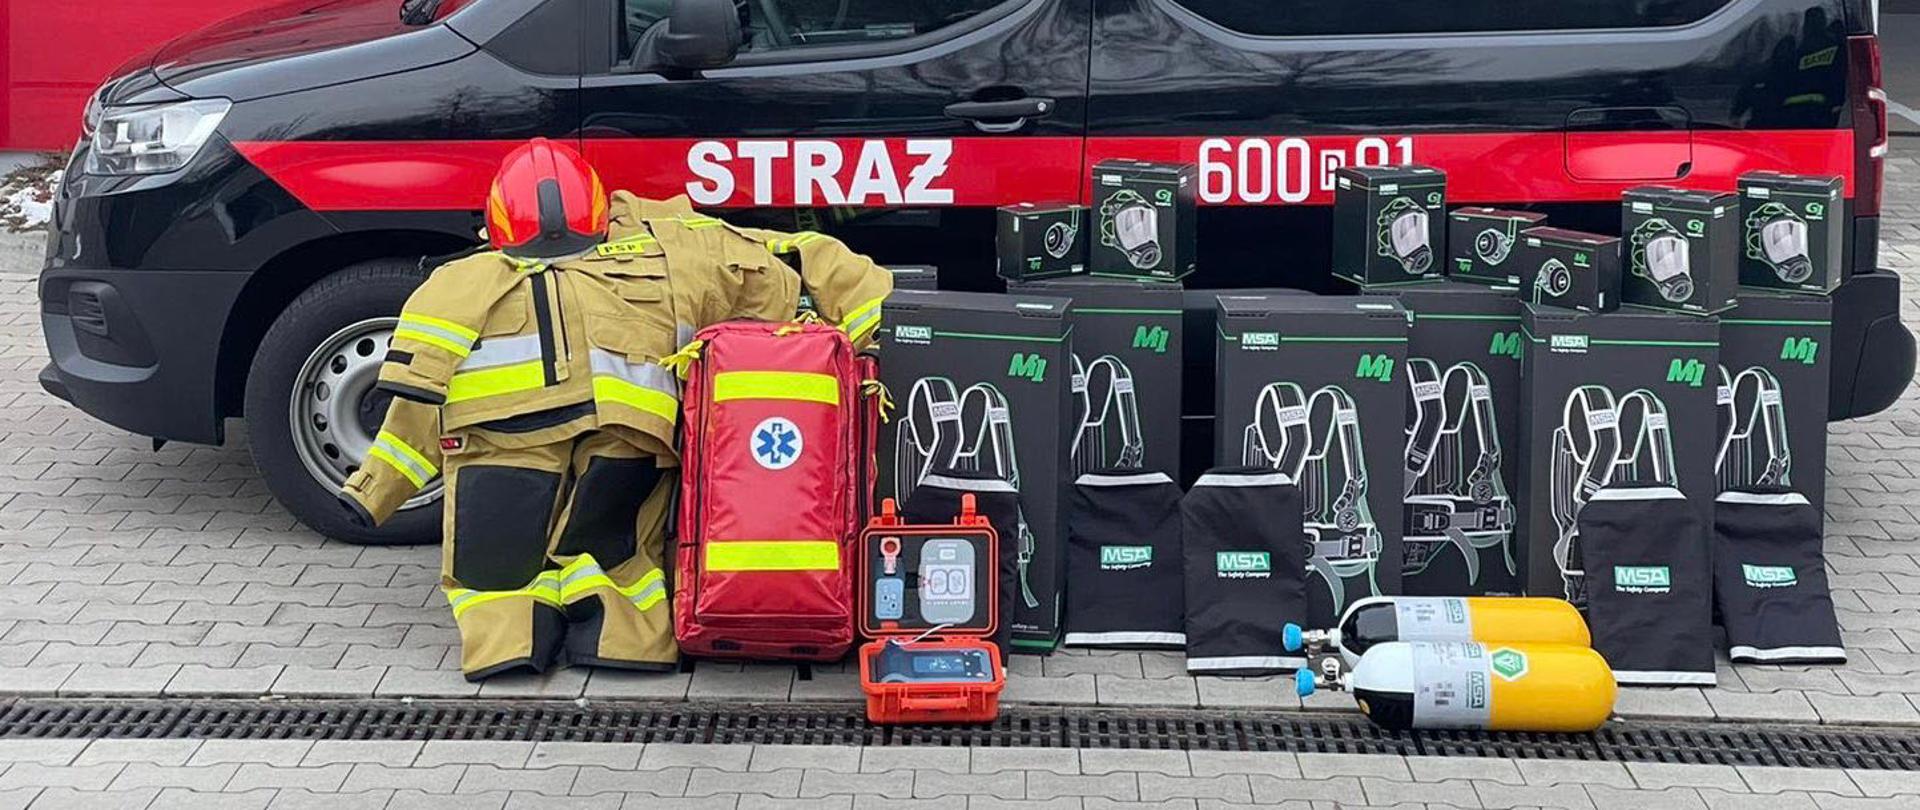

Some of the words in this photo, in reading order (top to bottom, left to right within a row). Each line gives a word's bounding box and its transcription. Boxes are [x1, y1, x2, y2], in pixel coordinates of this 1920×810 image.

[1199, 137, 1311, 203] 600
[603, 244, 637, 253] PSP
[896, 325, 931, 339] MSA
[1132, 325, 1169, 353] M1
[1242, 332, 1279, 345] MSA
[1551, 335, 1588, 348] MSA
[1780, 336, 1818, 364] M1
[1008, 353, 1047, 382] M1
[1356, 354, 1395, 382] M1
[1666, 358, 1705, 387] M1
[1102, 547, 1150, 563] MSA
[1219, 553, 1268, 569] MSA
[1616, 568, 1667, 585] MSA
[1745, 566, 1795, 581] MSA
[1471, 671, 1484, 708] MSA
